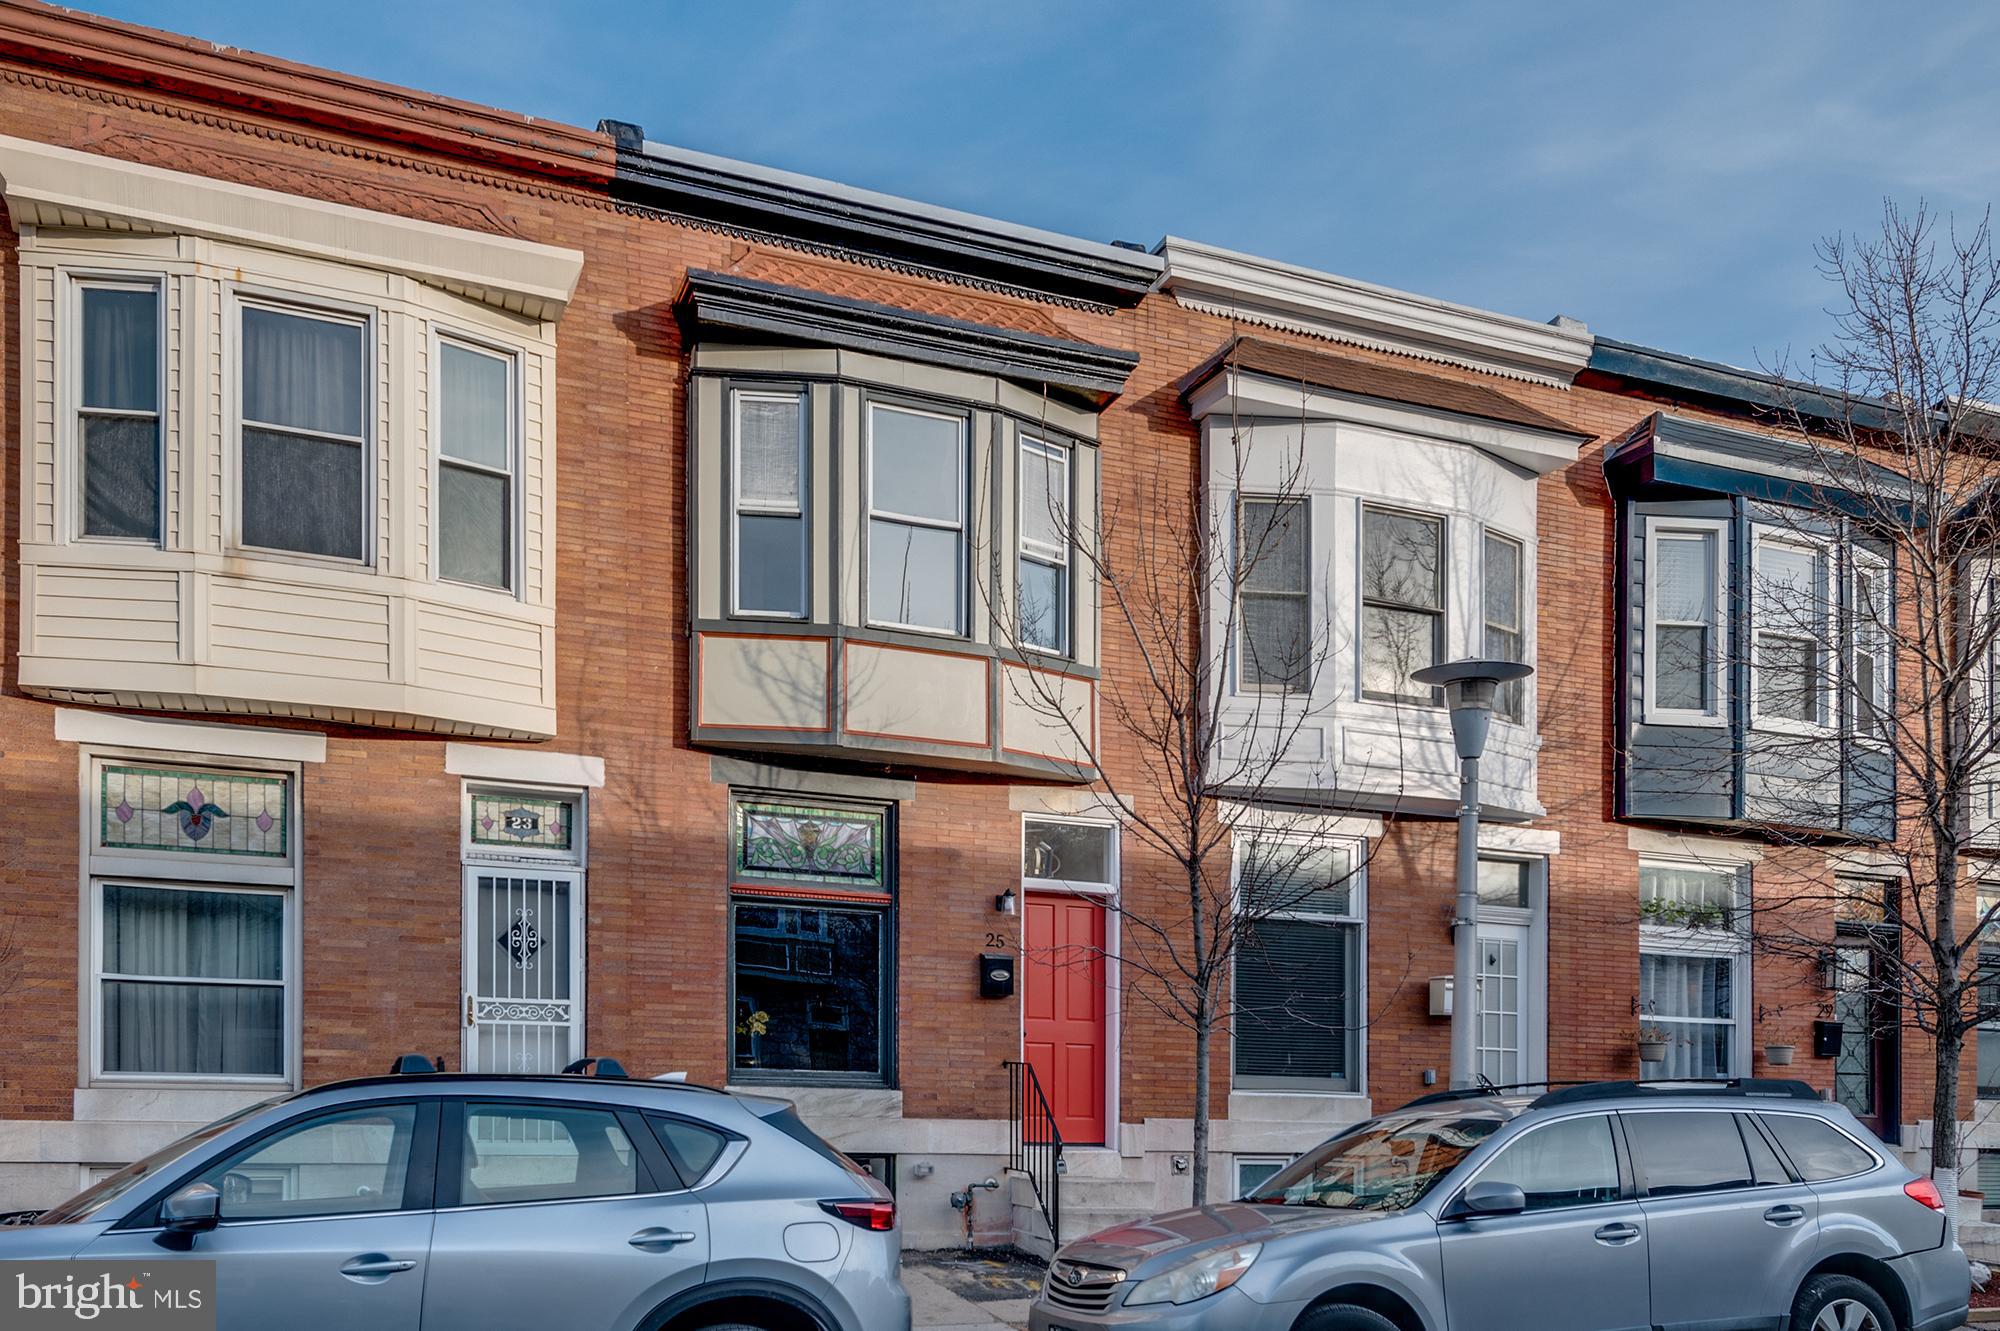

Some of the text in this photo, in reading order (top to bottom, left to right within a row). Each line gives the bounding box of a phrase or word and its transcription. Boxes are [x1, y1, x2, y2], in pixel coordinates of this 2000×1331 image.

[511, 816, 532, 830] 23
[986, 932, 1005, 949] 25
[1815, 1003, 1834, 1018] 29
